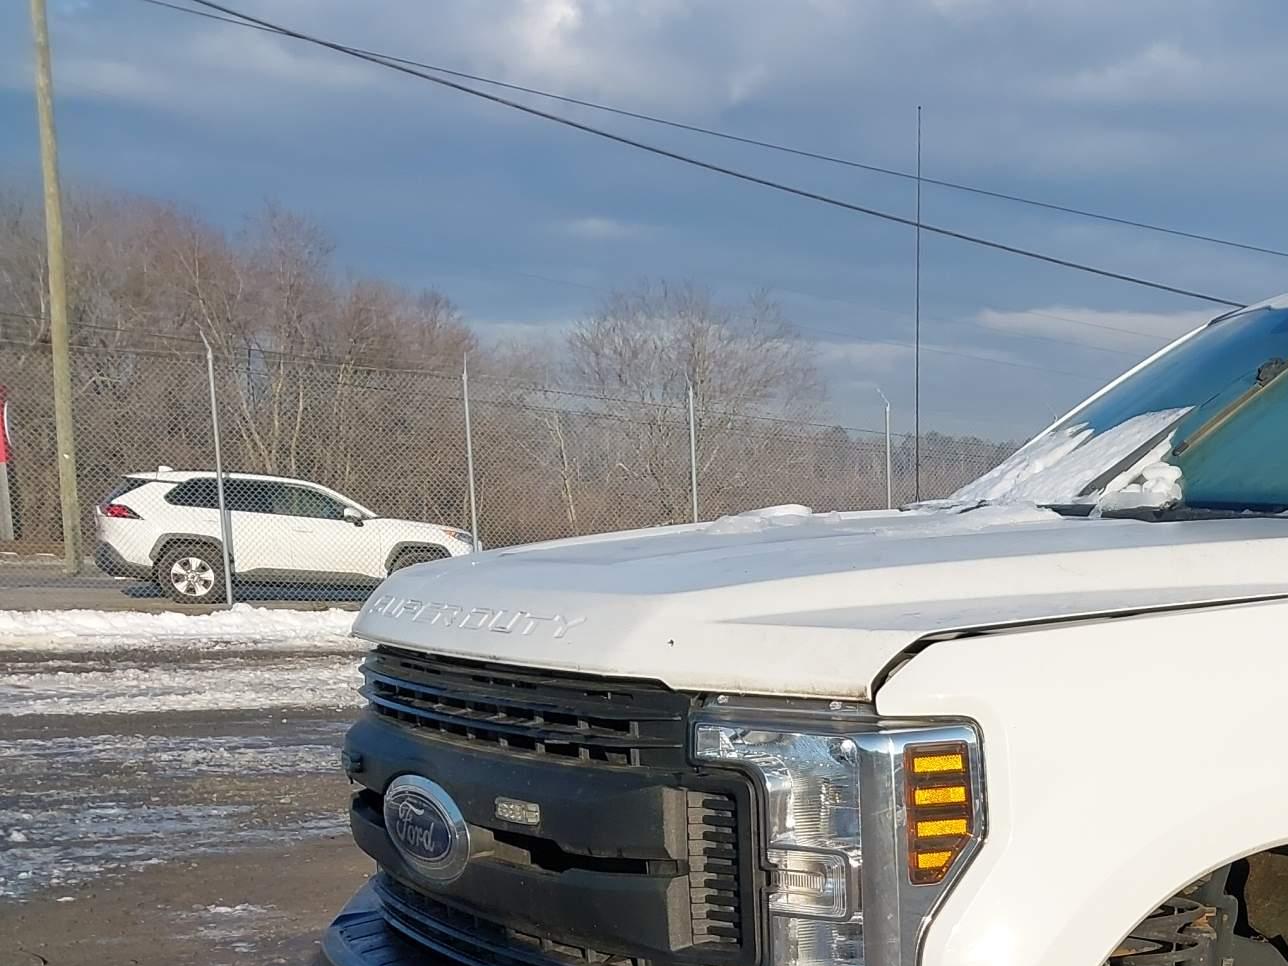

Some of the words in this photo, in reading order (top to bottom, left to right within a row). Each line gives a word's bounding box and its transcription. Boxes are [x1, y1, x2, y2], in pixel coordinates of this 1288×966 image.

[369, 595, 463, 627] SUPER
[459, 606, 588, 639] DUTY
[396, 798, 435, 851] Ford
